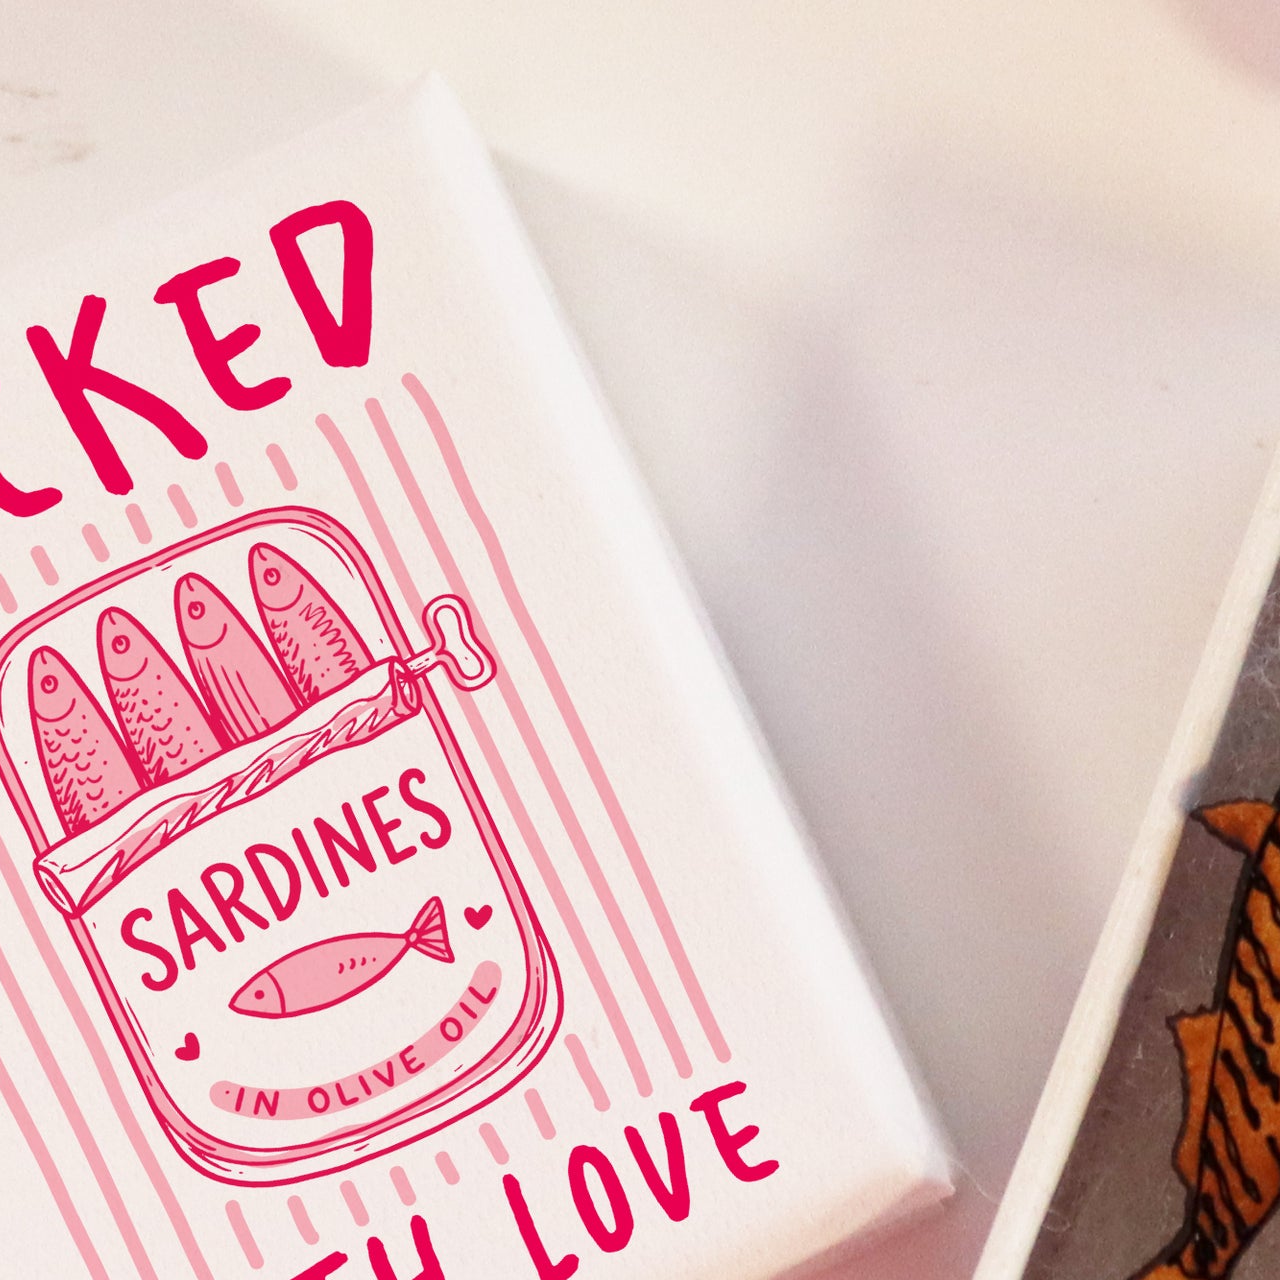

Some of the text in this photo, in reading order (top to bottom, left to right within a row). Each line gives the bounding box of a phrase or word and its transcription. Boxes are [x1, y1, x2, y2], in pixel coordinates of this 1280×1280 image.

[120, 768, 452, 992] SARDINES
[234, 985, 498, 1117] IN OLIVE OIL
